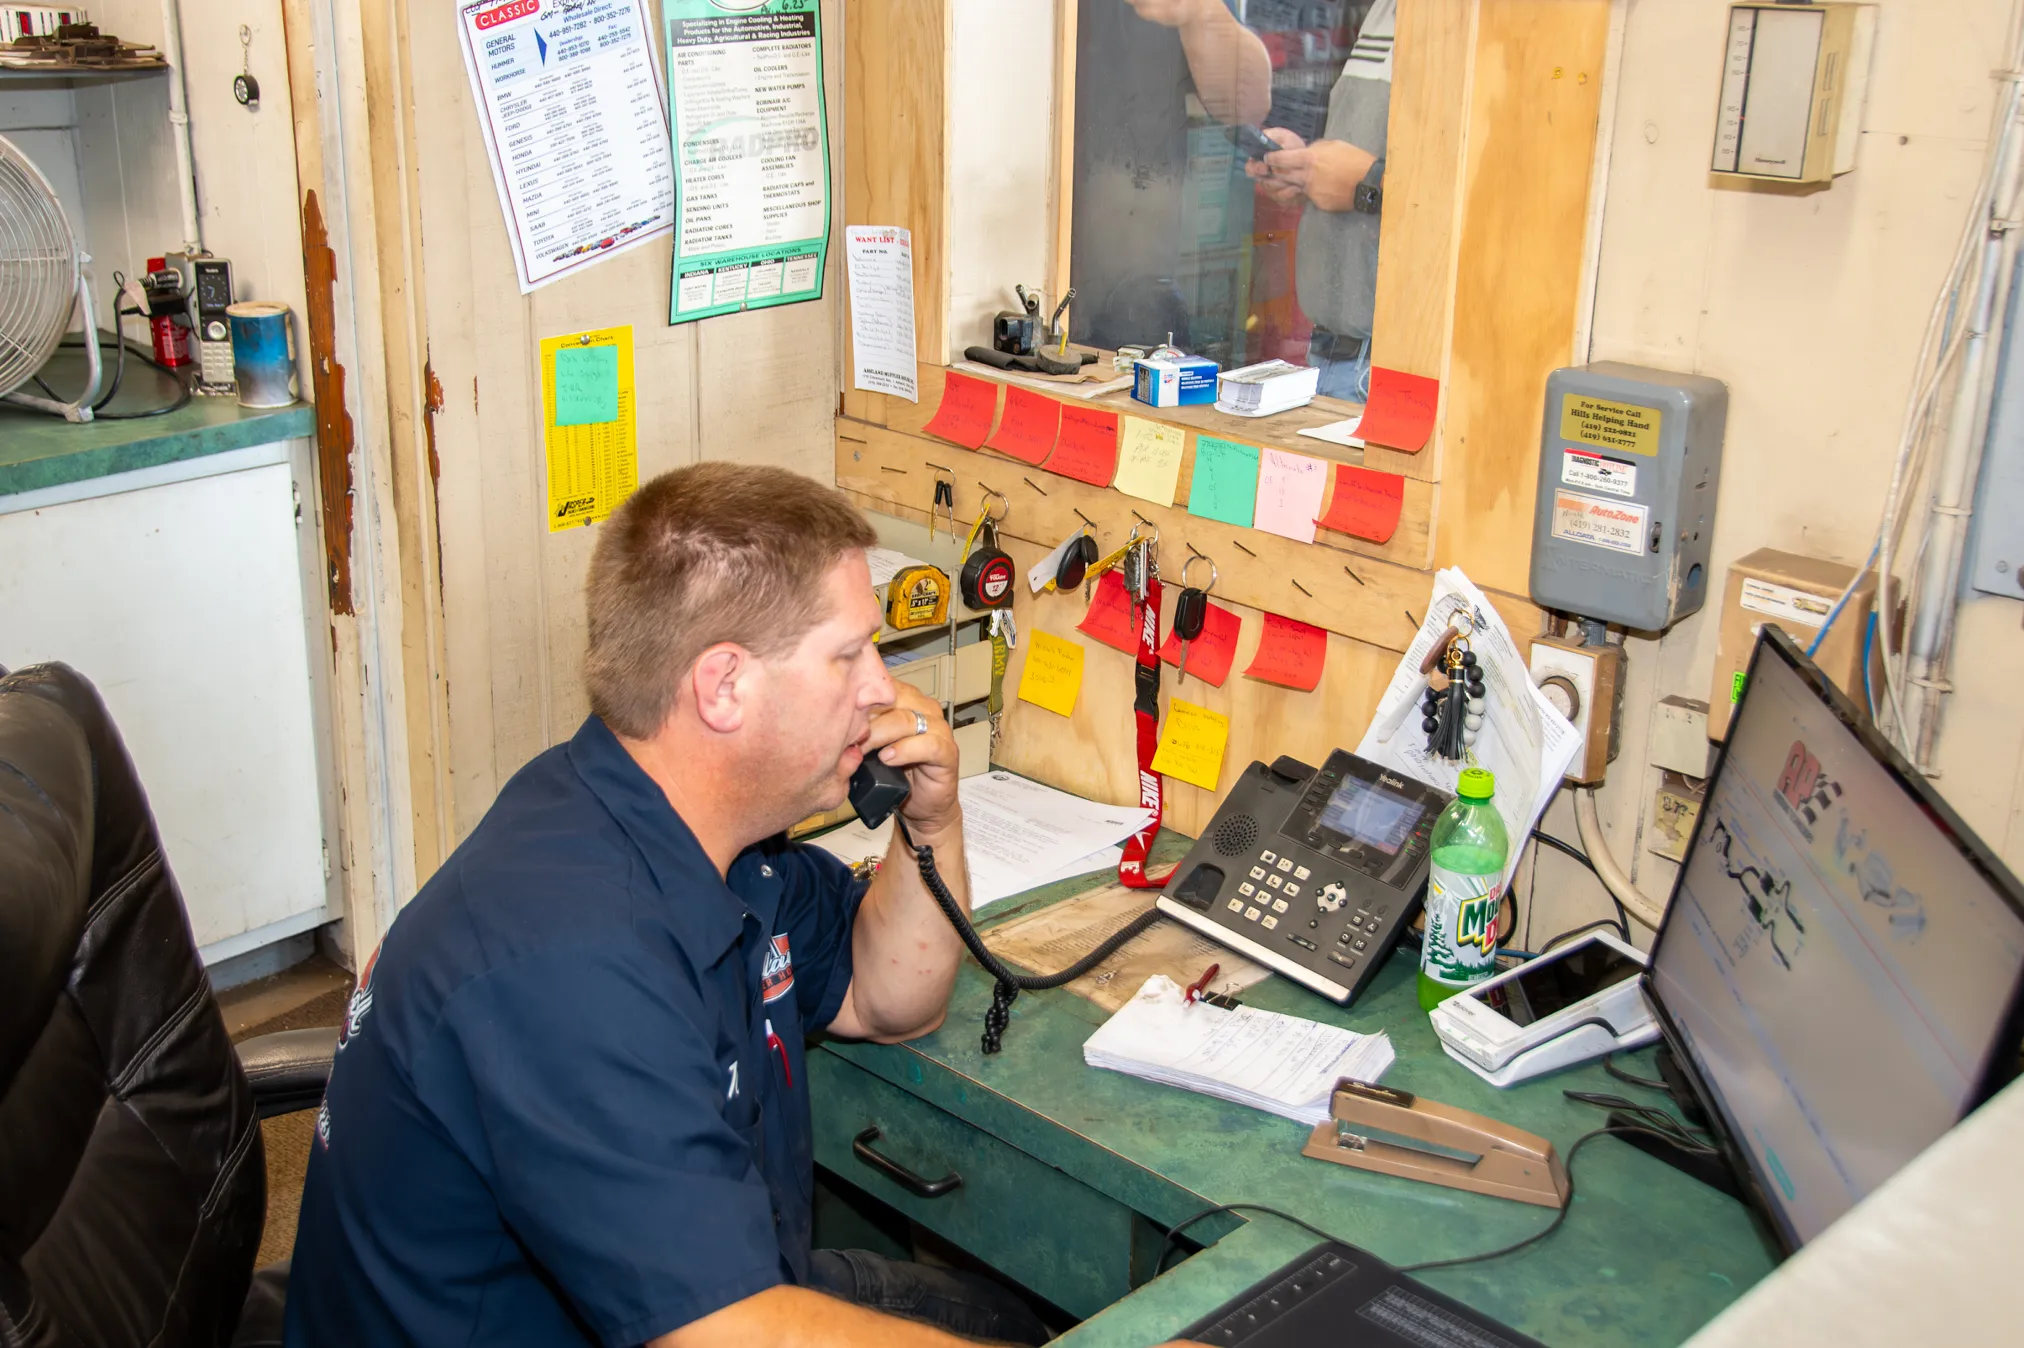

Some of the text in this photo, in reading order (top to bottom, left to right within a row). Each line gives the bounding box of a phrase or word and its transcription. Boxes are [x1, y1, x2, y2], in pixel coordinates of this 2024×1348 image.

[479, 1, 536, 28] CLASSIC
[563, 8, 593, 23] Wholesale
[593, 3, 613, 15] Direct:
[682, 13, 804, 28] Specializing in Engine Cooling & Heating
[683, 26, 711, 36] Products
[711, 26, 721, 34] for
[722, 24, 732, 33] the
[486, 34, 516, 49] GENERAL
[677, 36, 696, 46] Heavy
[713, 31, 750, 42] Agricultural
[751, 31, 758, 40] &
[758, 29, 780, 40] Racing
[780, 28, 811, 38] Industries
[488, 43, 515, 58] MOTORS
[687, 49, 727, 59] CONDITIONING
[752, 43, 812, 53] COMPLETE RADIATORS
[491, 58, 515, 70] HUMMER
[677, 59, 695, 67] PARTS
[763, 64, 788, 73] COOLERS
[494, 69, 526, 83] WORKHORSE
[755, 83, 806, 93] NEW WATER PUMPS
[497, 92, 512, 101] BMW
[500, 100, 527, 113] CHRYSLER
[756, 105, 787, 114] EQUIPMENT
[505, 122, 521, 132] FORD
[508, 134, 533, 148] GENESIS
[683, 138, 720, 148] CONDENSERS
[512, 149, 533, 161] HONDA
[684, 157, 707, 166] CHARGE
[718, 153, 743, 162] COOLERS
[760, 154, 796, 164] COOLING FAN
[1754, 156, 1787, 166] Honeywell
[515, 162, 541, 175] HYUNDAI
[761, 162, 794, 172] ASSEMBLIES
[519, 179, 539, 189] LEXUS
[685, 174, 725, 184] HEATER CORES
[762, 184, 789, 193] RADIATOR
[789, 182, 804, 190] CAPS
[523, 192, 543, 204] MAZDA
[686, 192, 718, 202] GAS TANKS
[763, 189, 800, 200] THERMOSTATS
[686, 202, 729, 214] SENDING UNITS
[763, 199, 822, 213] MISCELLANEOUS SHOP
[526, 209, 540, 218] MINI
[695, 215, 712, 223] PANS
[763, 211, 788, 221] SUPPLIES
[530, 222, 546, 232] SAAB
[685, 223, 734, 235] RADIATOR CORES
[534, 234, 555, 246] TOYOTA
[684, 233, 733, 246] RADIATOR TANKS
[855, 235, 896, 245] WANT LIST
[536, 242, 569, 260] VOLKSWAGEN
[700, 247, 802, 268] SIX WAREHOUSE LOCATIONS
[760, 258, 775, 267] OHIO
[786, 252, 818, 263] TENNESSEE
[684, 268, 710, 279] INDIANA
[718, 262, 748, 274] KENTUCKY
[1580, 400, 1642, 418] For Service Call
[1570, 408, 1650, 430] Hills Helping Hand
[1581, 420, 1637, 438] (419) 522-0821
[1580, 430, 1637, 448] (419) 631-2777
[1571, 455, 1600, 467] DIAGNOSTIC
[1568, 470, 1580, 478] Call
[1589, 505, 1640, 525] AutoZone
[1563, 528, 1596, 541] ALLDATA
[1570, 519, 1631, 539] (419) 281-2832
[1142, 603, 1156, 649] NIKE
[993, 636, 1005, 676] ARMY
[1379, 773, 1405, 790] Yealink
[1140, 770, 1159, 811] NIKE
